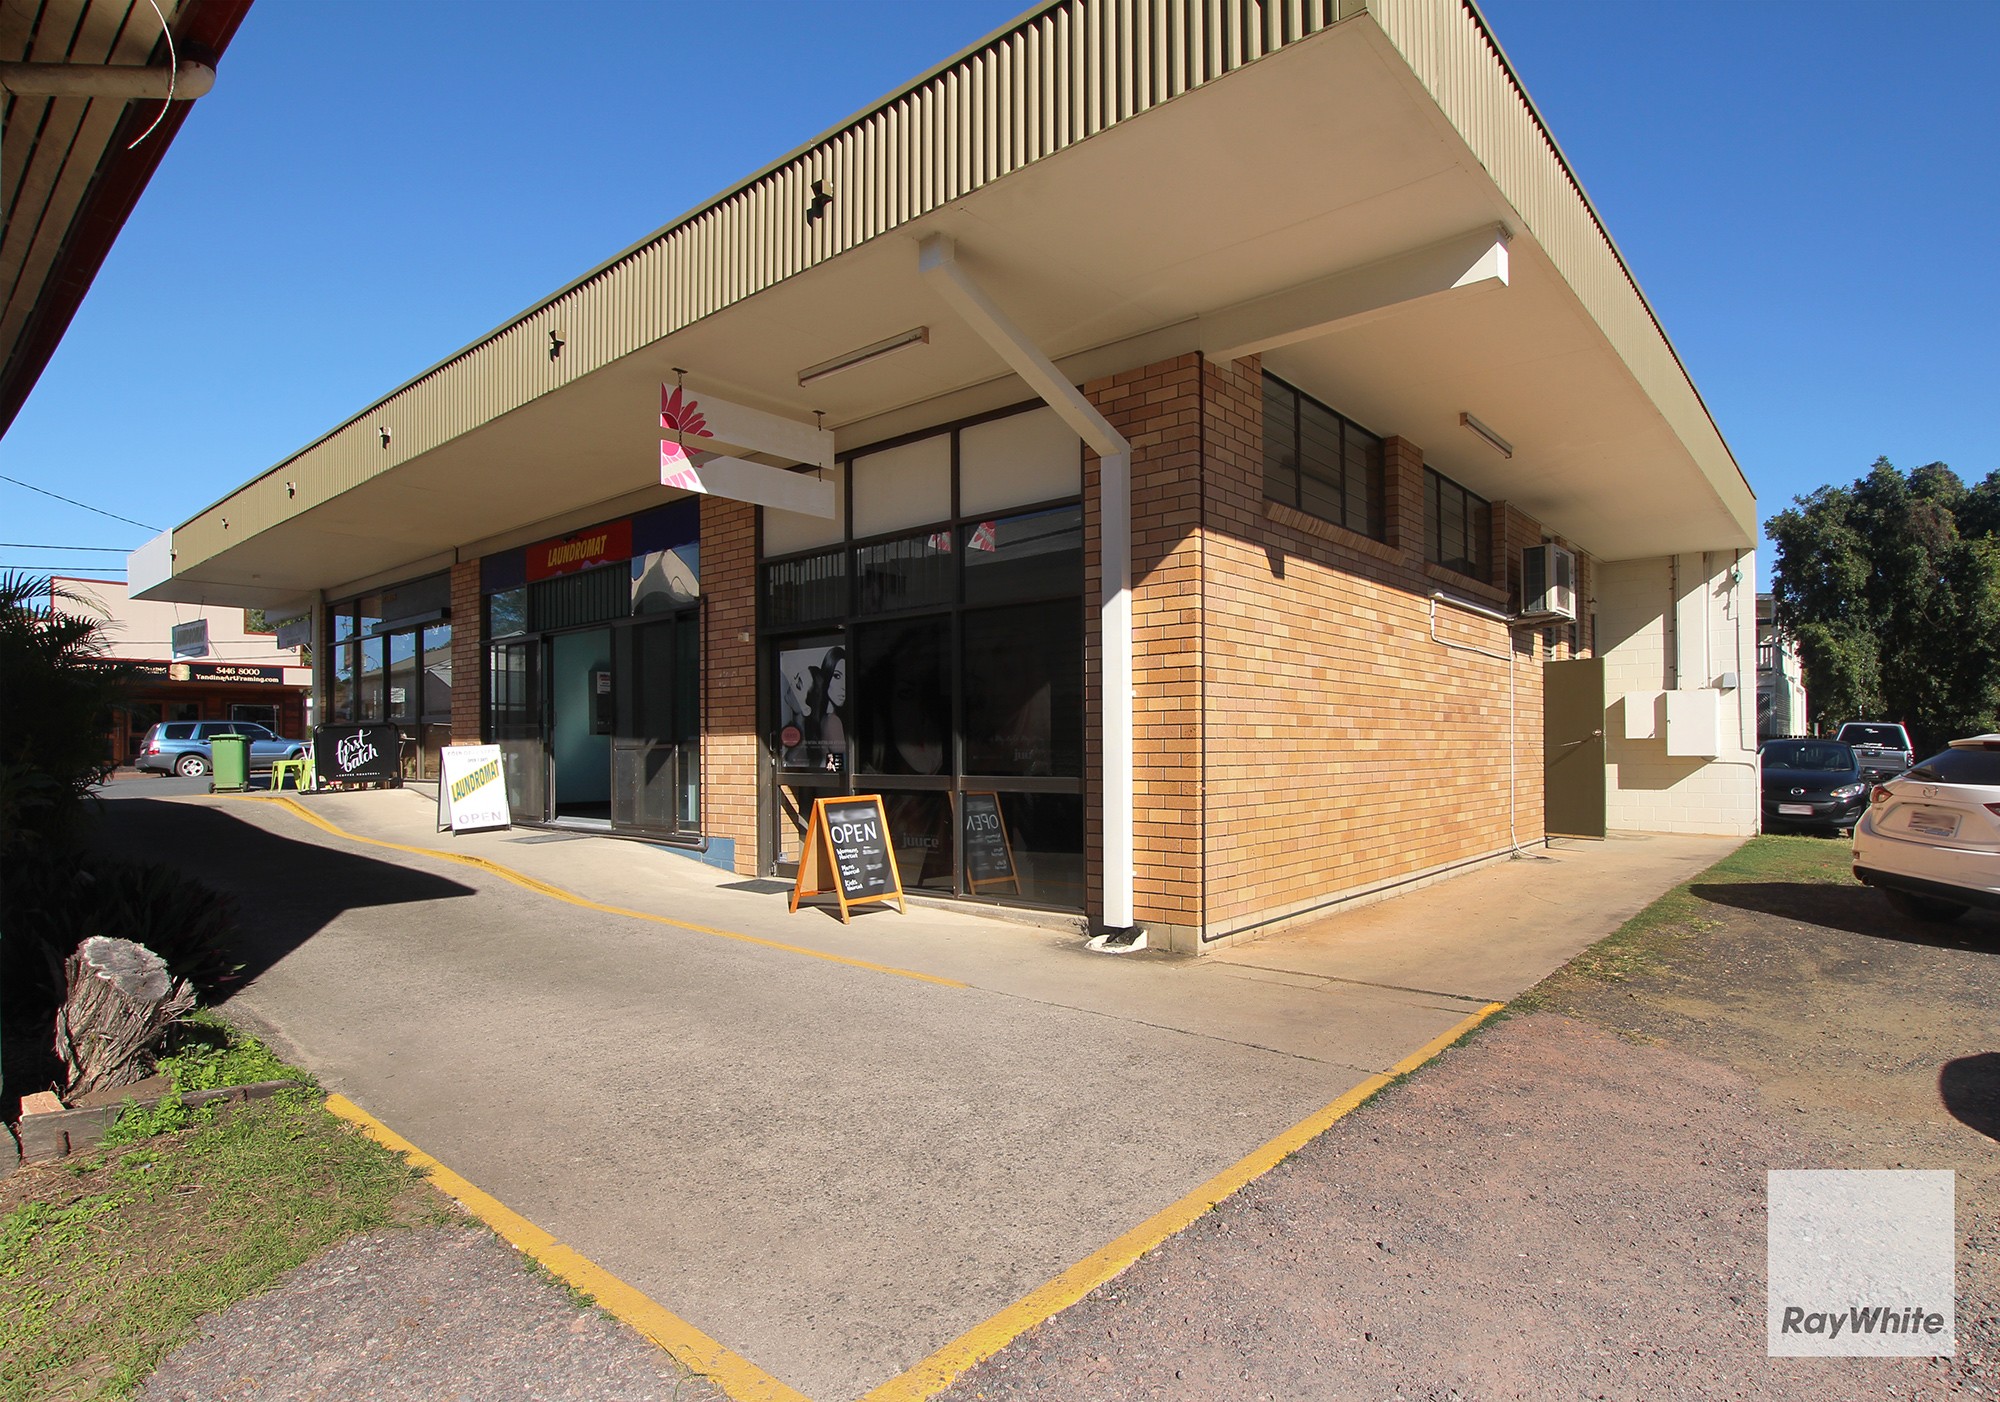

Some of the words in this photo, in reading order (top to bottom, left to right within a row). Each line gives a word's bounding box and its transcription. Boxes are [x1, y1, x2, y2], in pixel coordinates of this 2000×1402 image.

[547, 534, 608, 568] LAUNDROMAT
[216, 667, 236, 675] 5446
[237, 667, 260, 676] 8000
[335, 729, 372, 765] first
[340, 743, 379, 772] batch
[450, 758, 500, 803] LAUNDROMAT
[458, 811, 502, 825] OPEN
[830, 820, 877, 844] OPEN
[901, 832, 939, 849] juuce
